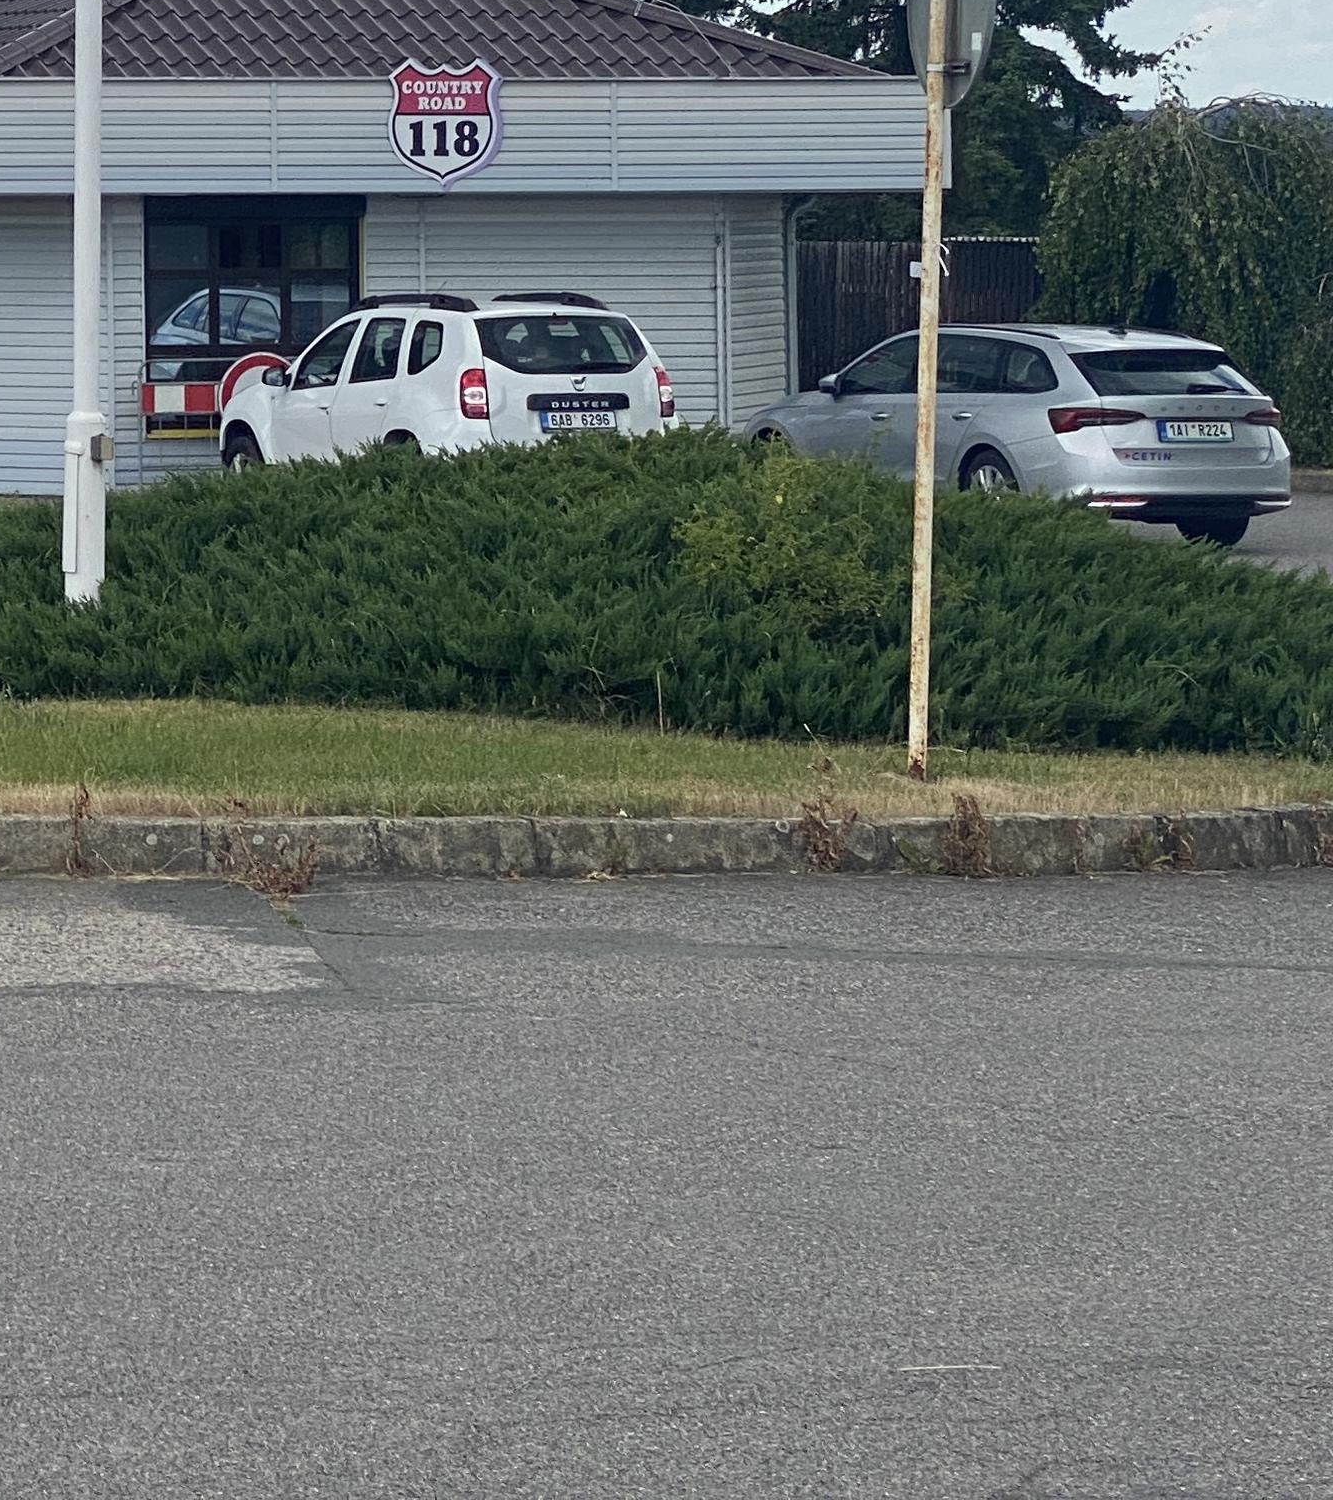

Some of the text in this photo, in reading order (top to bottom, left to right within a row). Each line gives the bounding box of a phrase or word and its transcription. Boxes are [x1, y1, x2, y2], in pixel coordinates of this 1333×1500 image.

[402, 81, 484, 94] COUNTRY
[418, 97, 467, 110] ROAD
[409, 120, 480, 157] 118
[551, 401, 610, 409] DUSTER
[1132, 451, 1173, 461] CETIN
